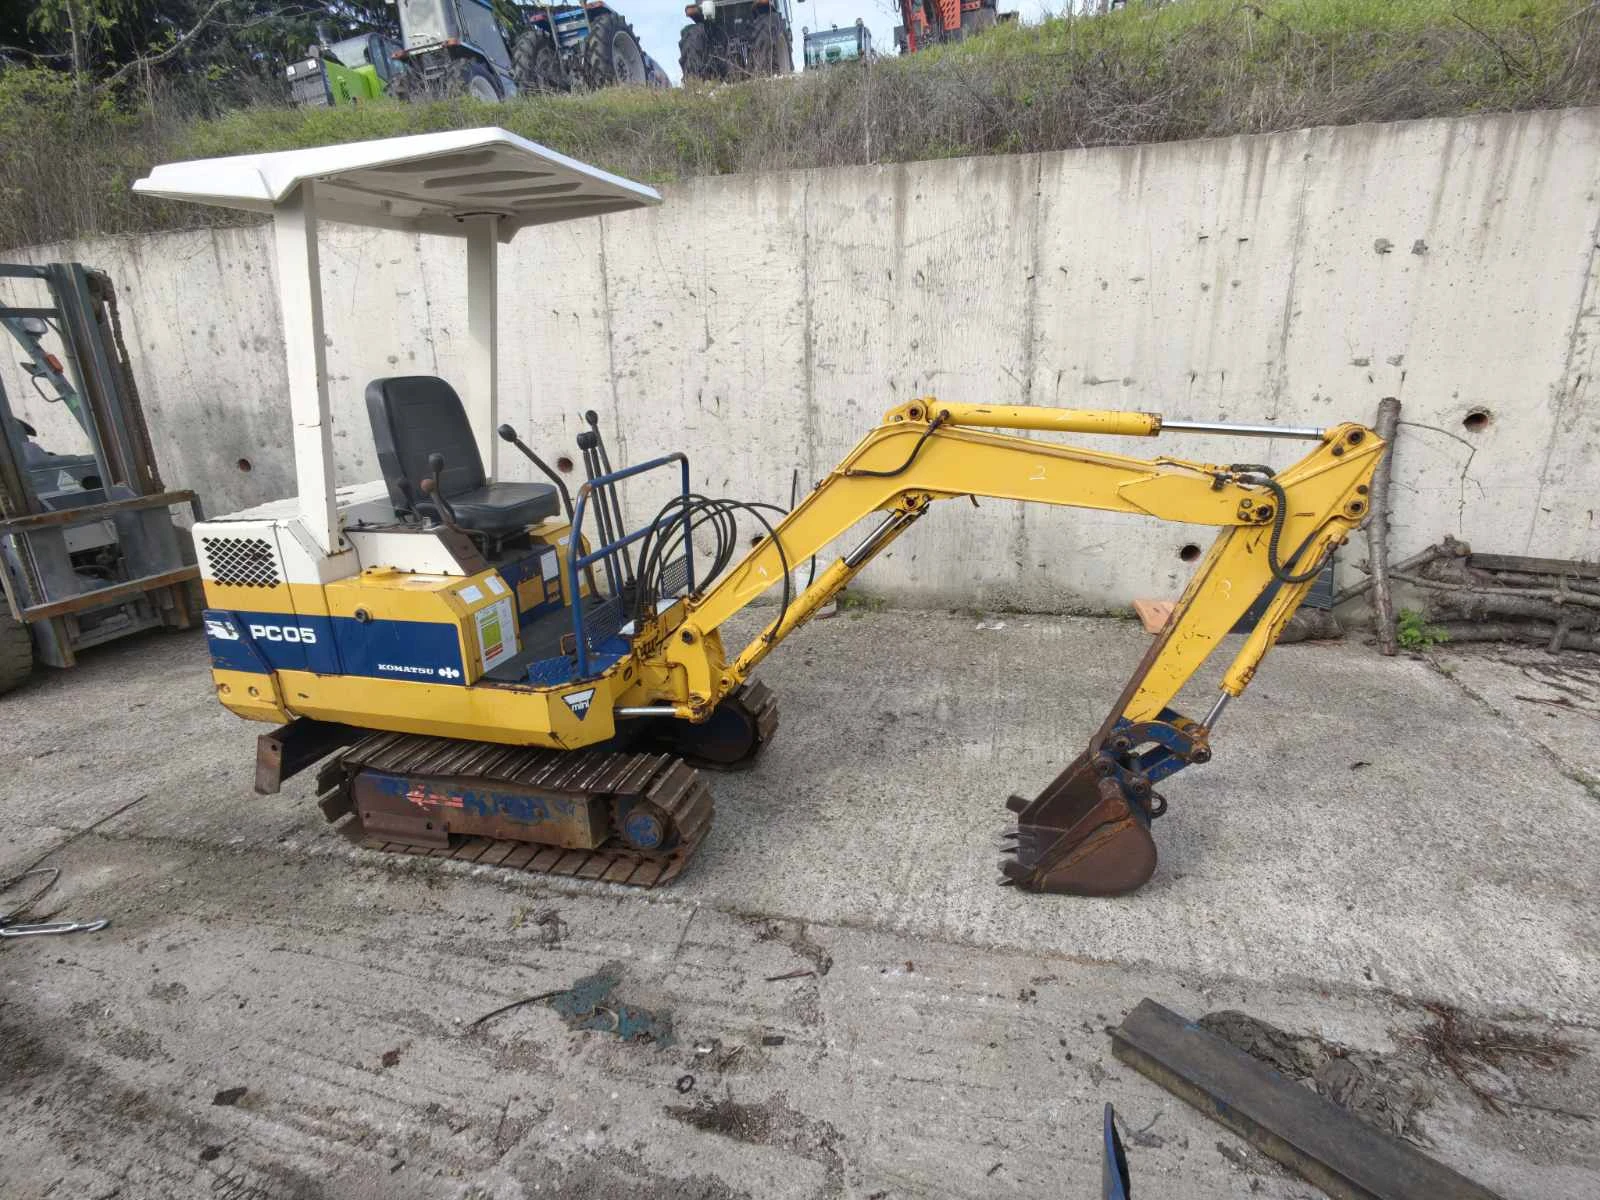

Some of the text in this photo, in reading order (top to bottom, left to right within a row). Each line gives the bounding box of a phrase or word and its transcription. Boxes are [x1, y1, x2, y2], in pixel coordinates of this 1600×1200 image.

[1029, 464, 1046, 480] 2
[249, 624, 317, 644] PC05
[377, 663, 434, 675] KOMATSU
